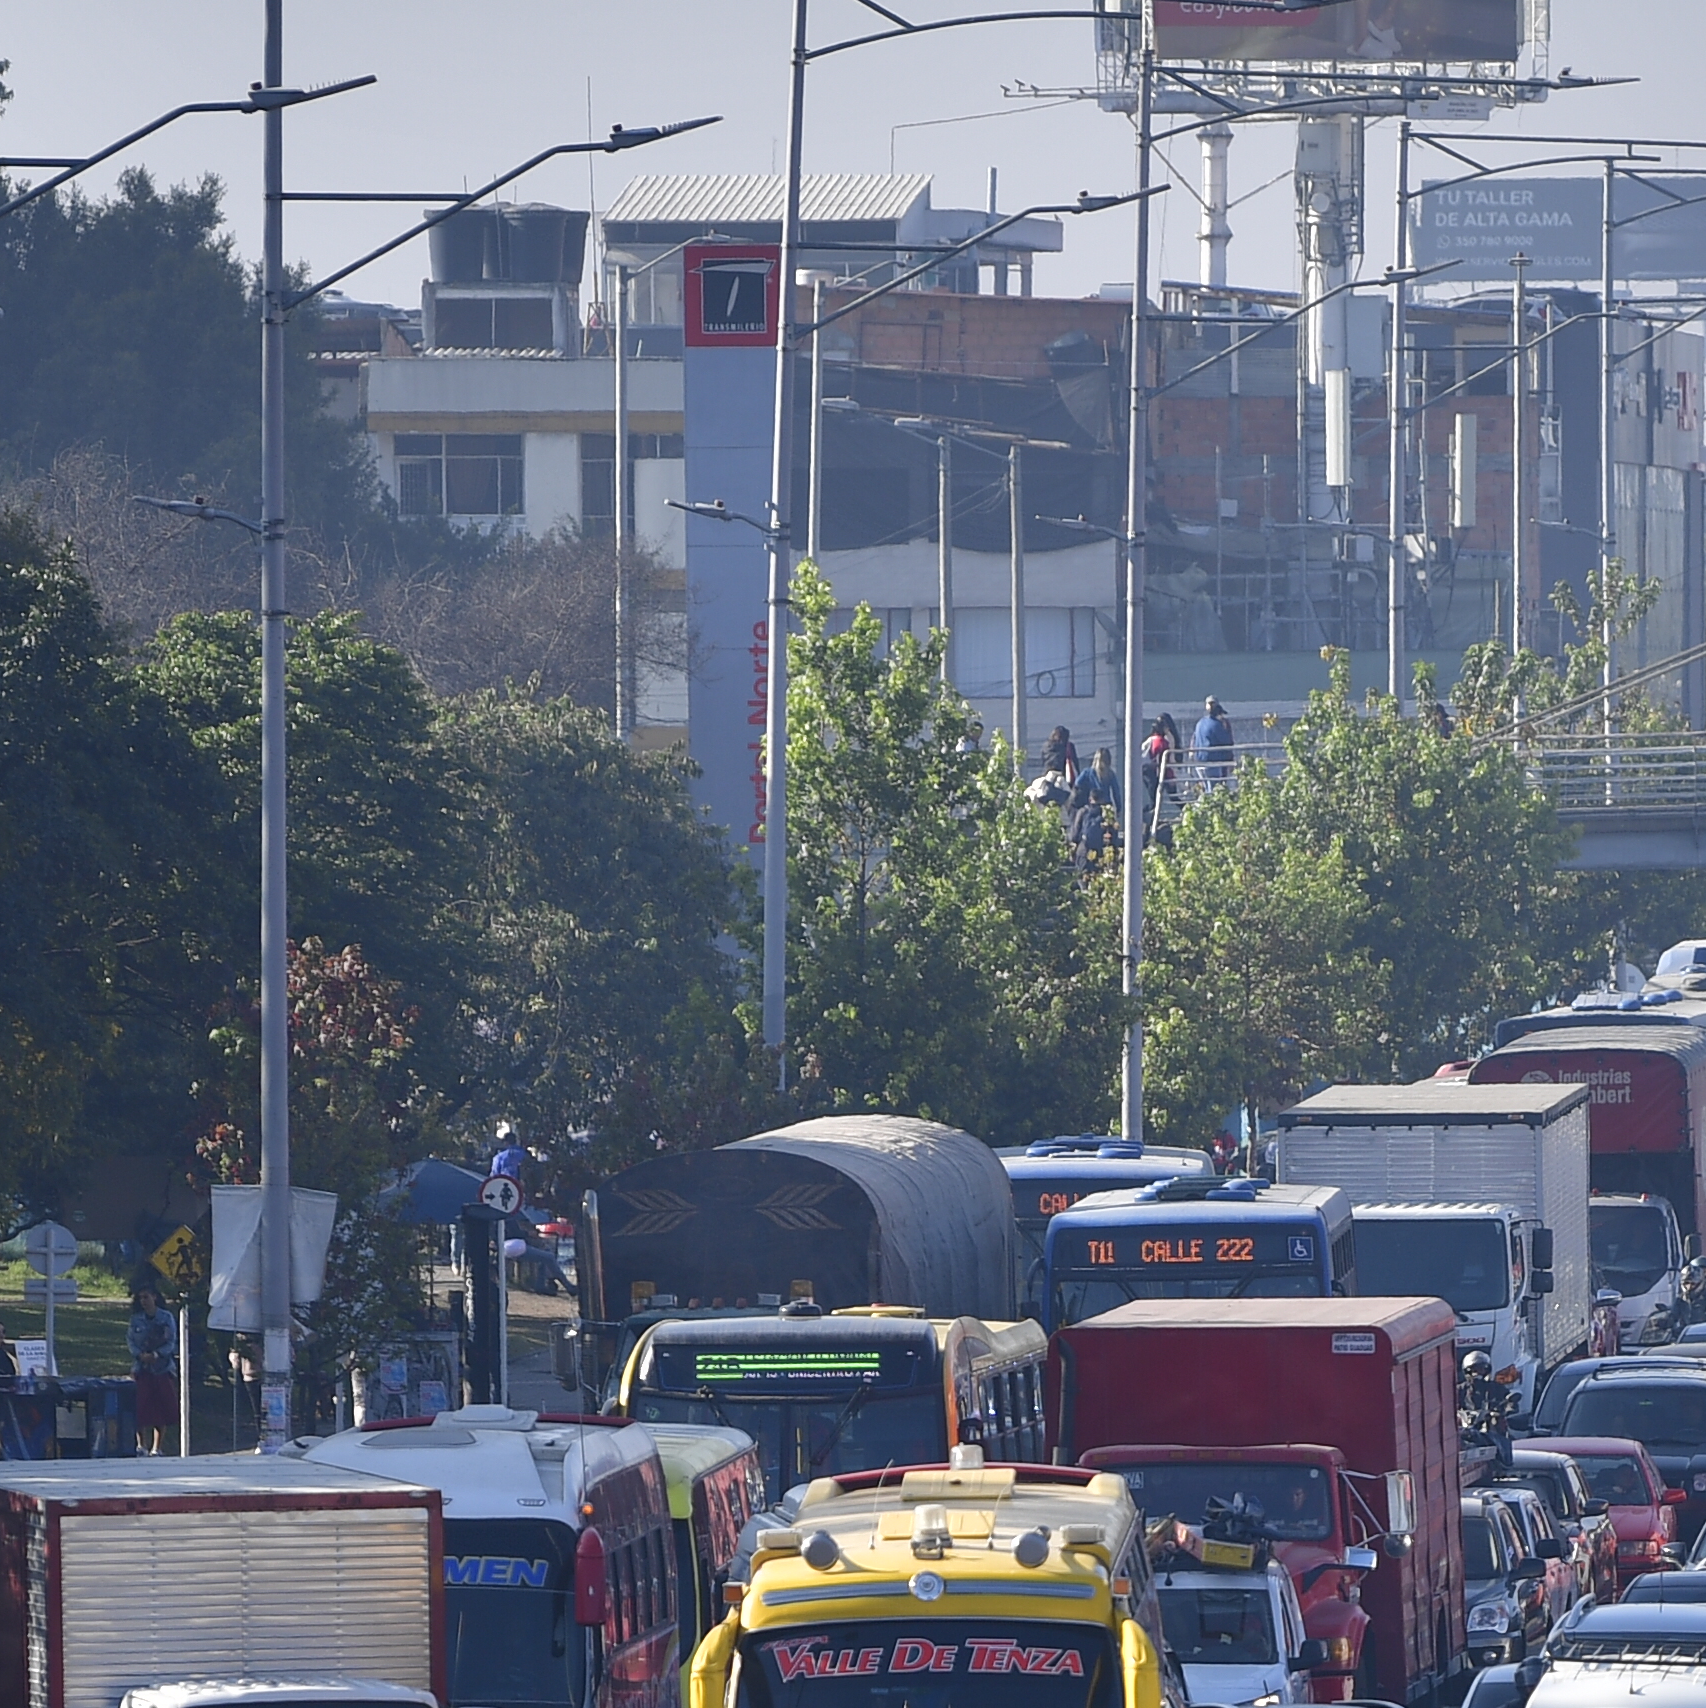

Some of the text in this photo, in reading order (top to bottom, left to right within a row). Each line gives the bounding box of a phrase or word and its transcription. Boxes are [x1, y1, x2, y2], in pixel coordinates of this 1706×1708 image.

[1435, 190, 1533, 205] TU TALLER
[1435, 212, 1572, 226] DE ALTA GAMA
[704, 323, 765, 331] TRANSMILENIO
[747, 620, 769, 726] Norte
[1559, 1069, 1631, 1084] Industrias
[1088, 1237, 1254, 1264] T11 CALLE 222
